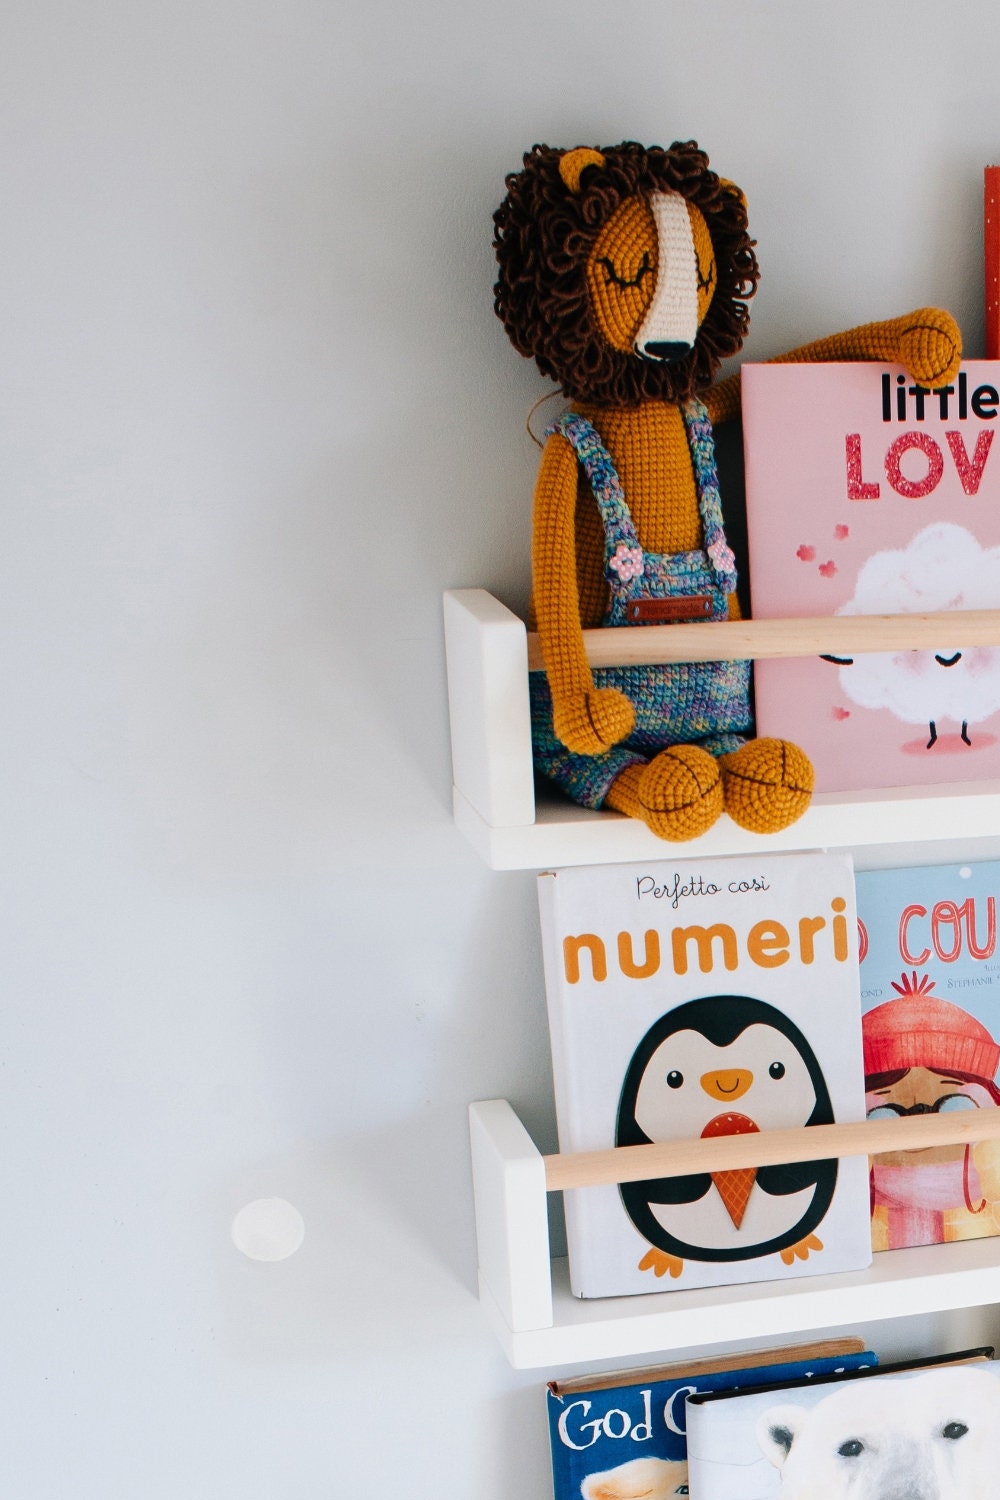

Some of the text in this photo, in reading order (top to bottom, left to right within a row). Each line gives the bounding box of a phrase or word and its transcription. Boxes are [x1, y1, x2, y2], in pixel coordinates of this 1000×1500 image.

[881, 372, 1000, 423] little
[636, 873, 722, 909] Perfetto
[563, 897, 849, 985] numeri
[558, 1389, 653, 1450] God
